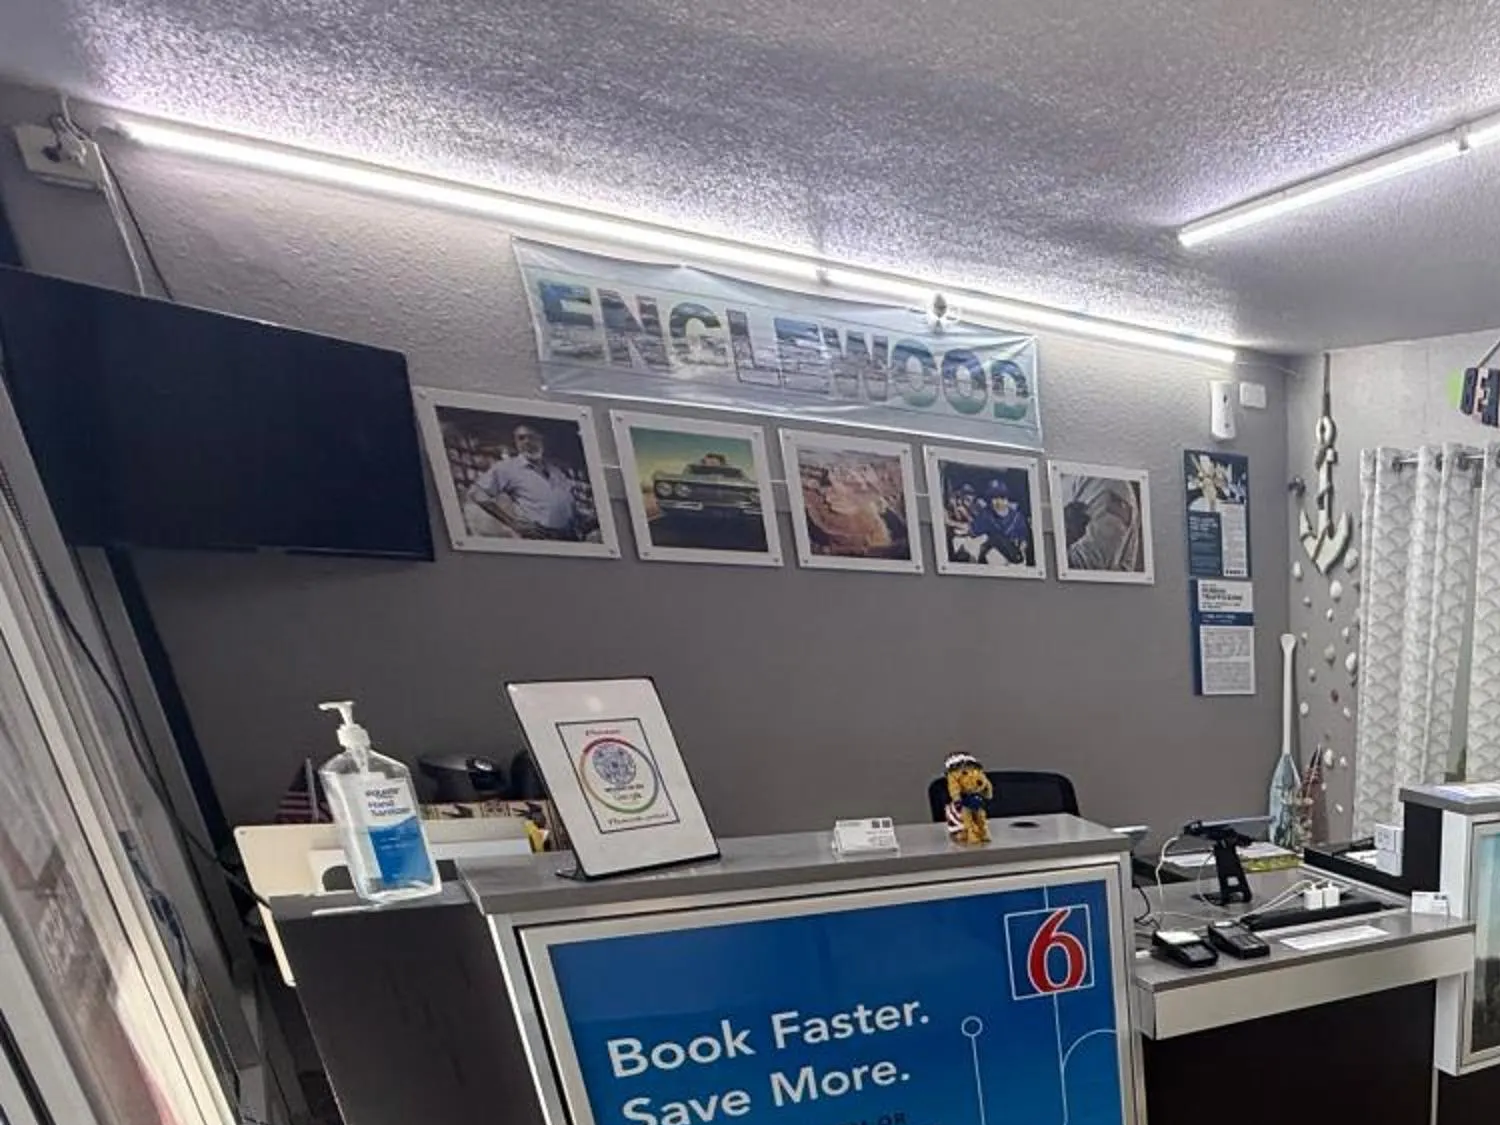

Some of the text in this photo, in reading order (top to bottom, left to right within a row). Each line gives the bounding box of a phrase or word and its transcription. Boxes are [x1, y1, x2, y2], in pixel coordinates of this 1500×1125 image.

[537, 280, 1031, 421] ENGLEWOOD
[1027, 906, 1087, 994] 6
[607, 999, 930, 1079] Book Faster.
[770, 1057, 909, 1108] More.
